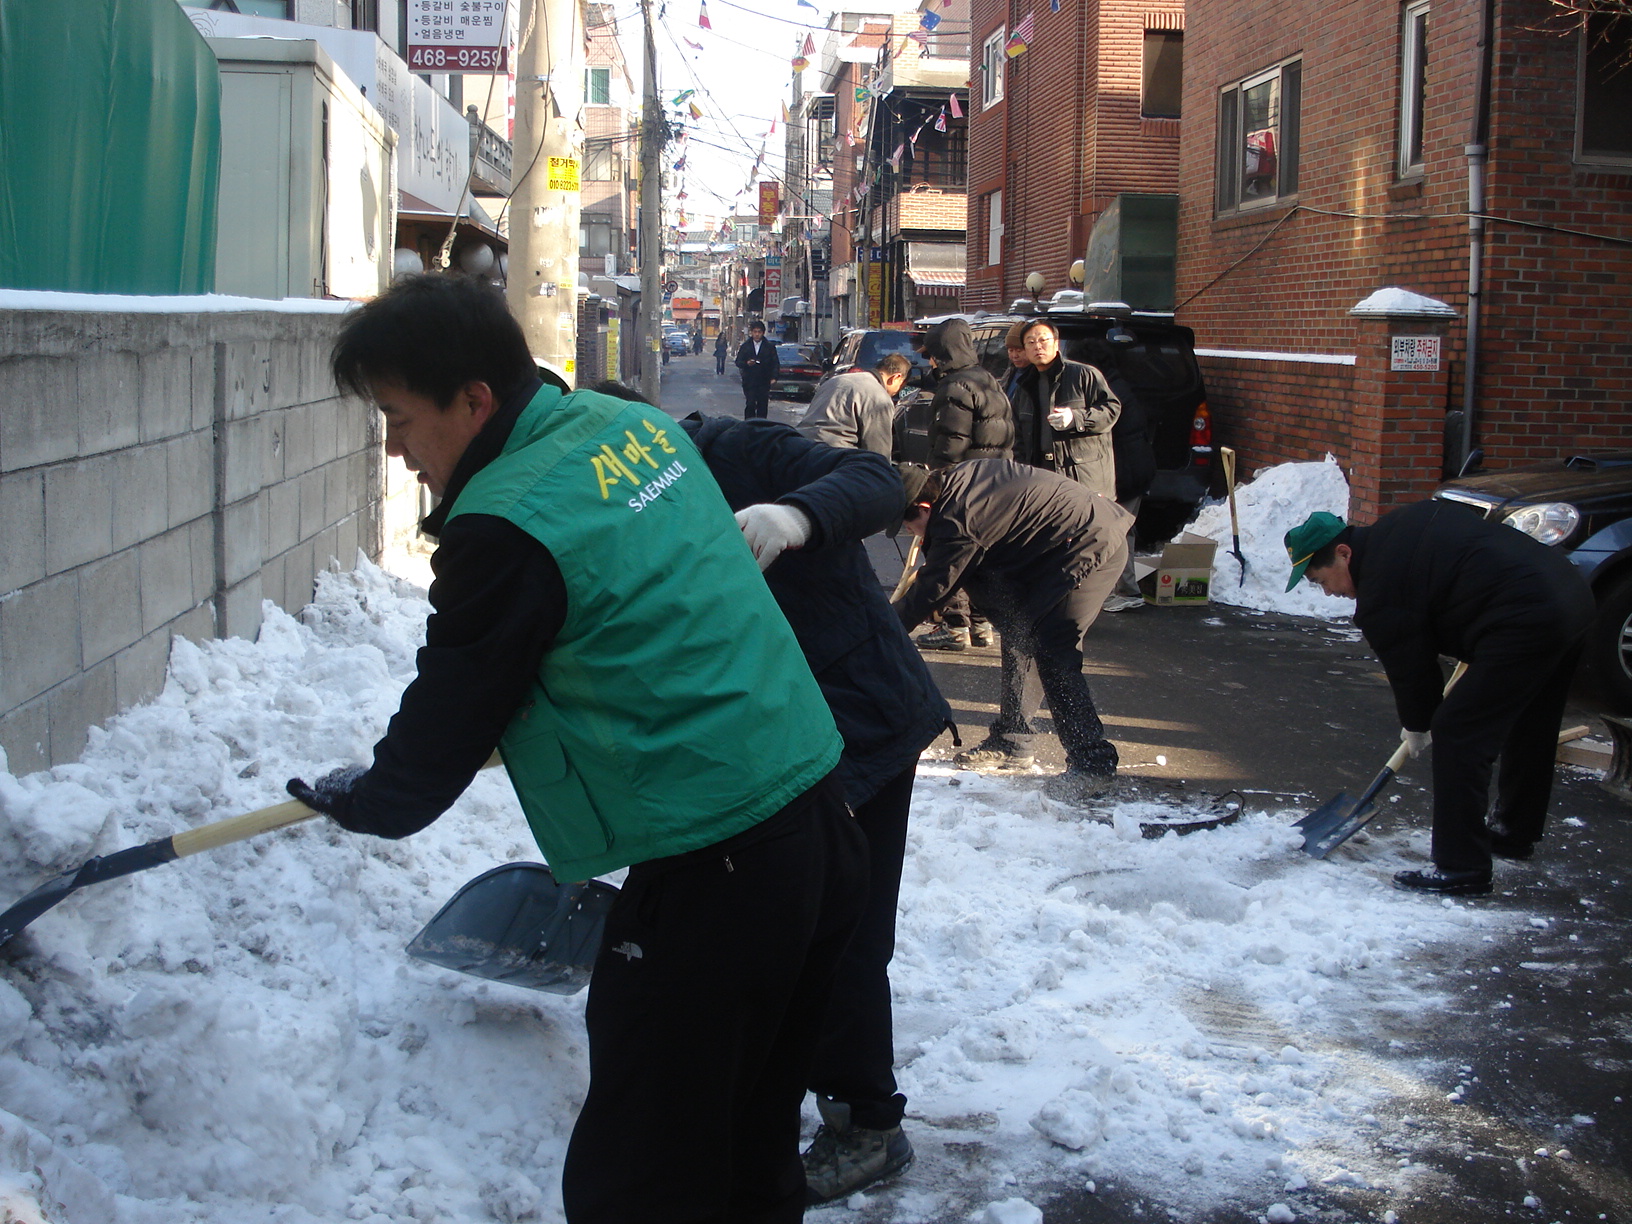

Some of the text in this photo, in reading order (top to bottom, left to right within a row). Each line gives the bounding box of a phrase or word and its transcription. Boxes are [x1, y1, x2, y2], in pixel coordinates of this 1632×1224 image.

[421, 1, 504, 12] 등갈비 숯불구이
[421, 15, 493, 27] 등갈비 매운찜
[421, 29, 465, 40] 얼음냉면
[412, 49, 502, 67] 468-9259
[1393, 338, 1439, 357] 외부차량 주차금지
[590, 419, 677, 500] 새마을
[628, 460, 688, 513] SAEMAUL
